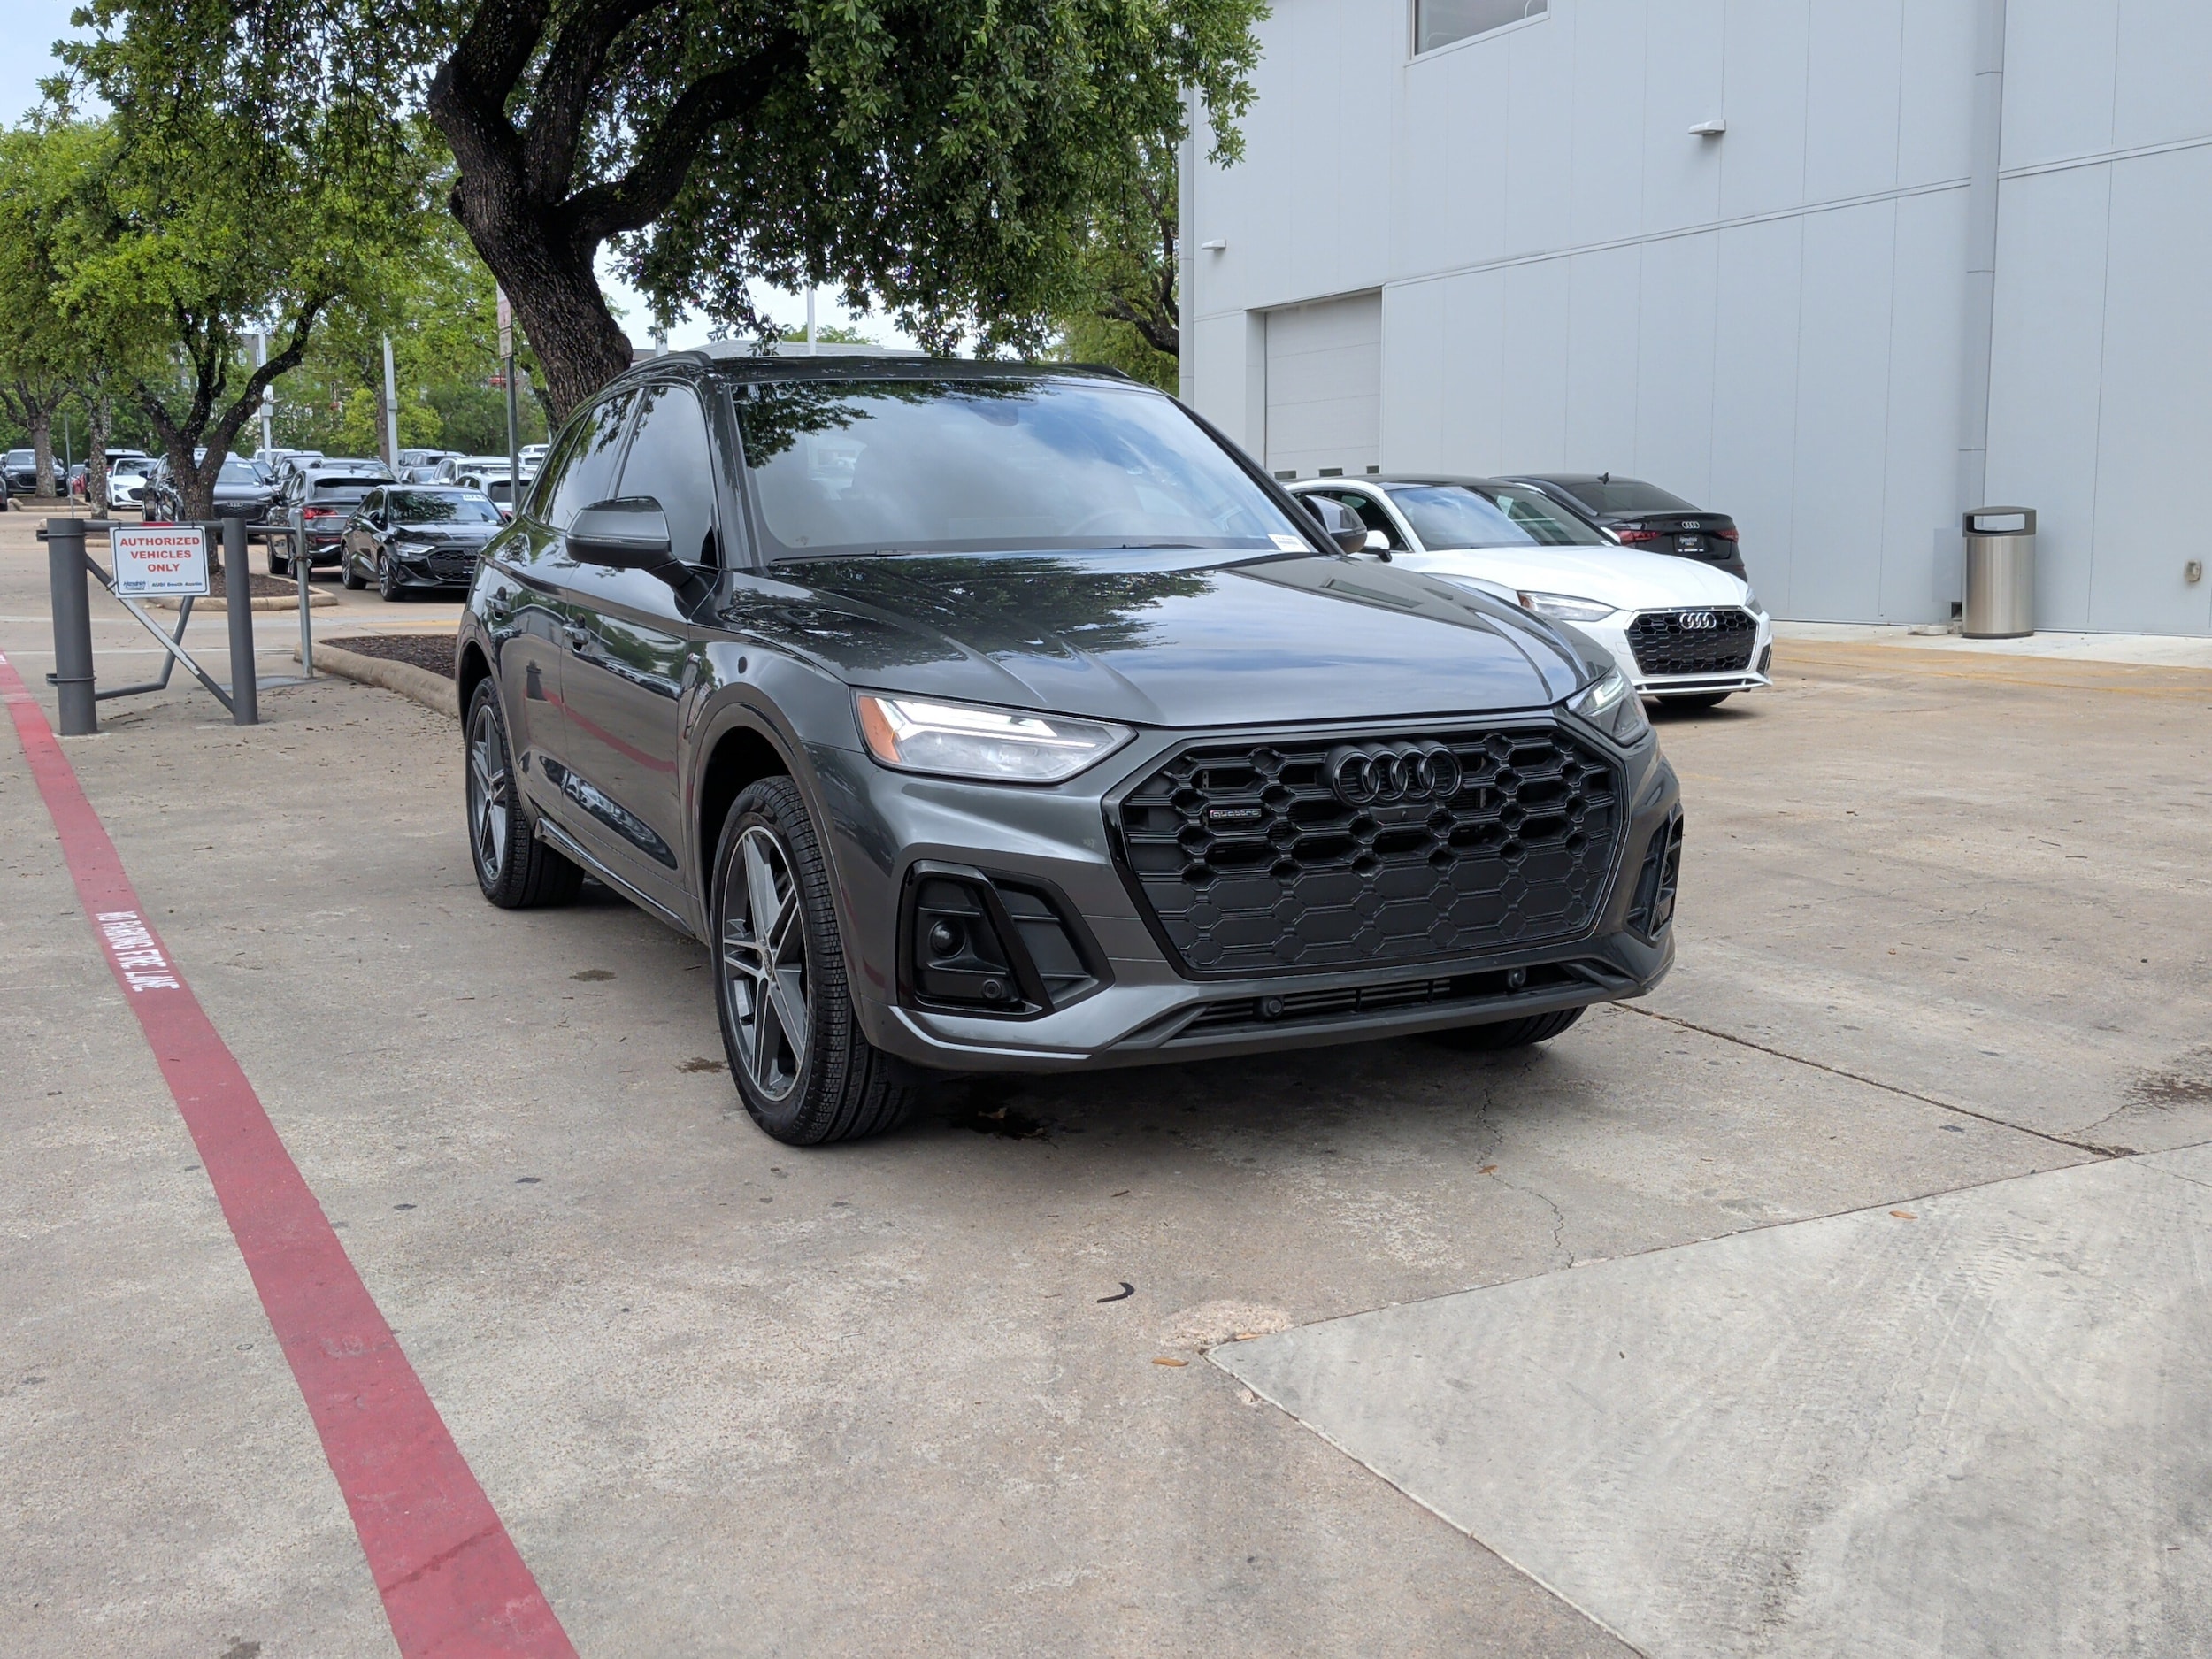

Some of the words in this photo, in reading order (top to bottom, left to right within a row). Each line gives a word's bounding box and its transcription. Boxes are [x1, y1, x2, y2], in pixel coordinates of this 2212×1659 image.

[120, 537, 200, 547] AUTHORIZED
[130, 550, 192, 559] VEHICLES
[115, 949, 166, 969] FIRE
[124, 970, 180, 992] LANE
